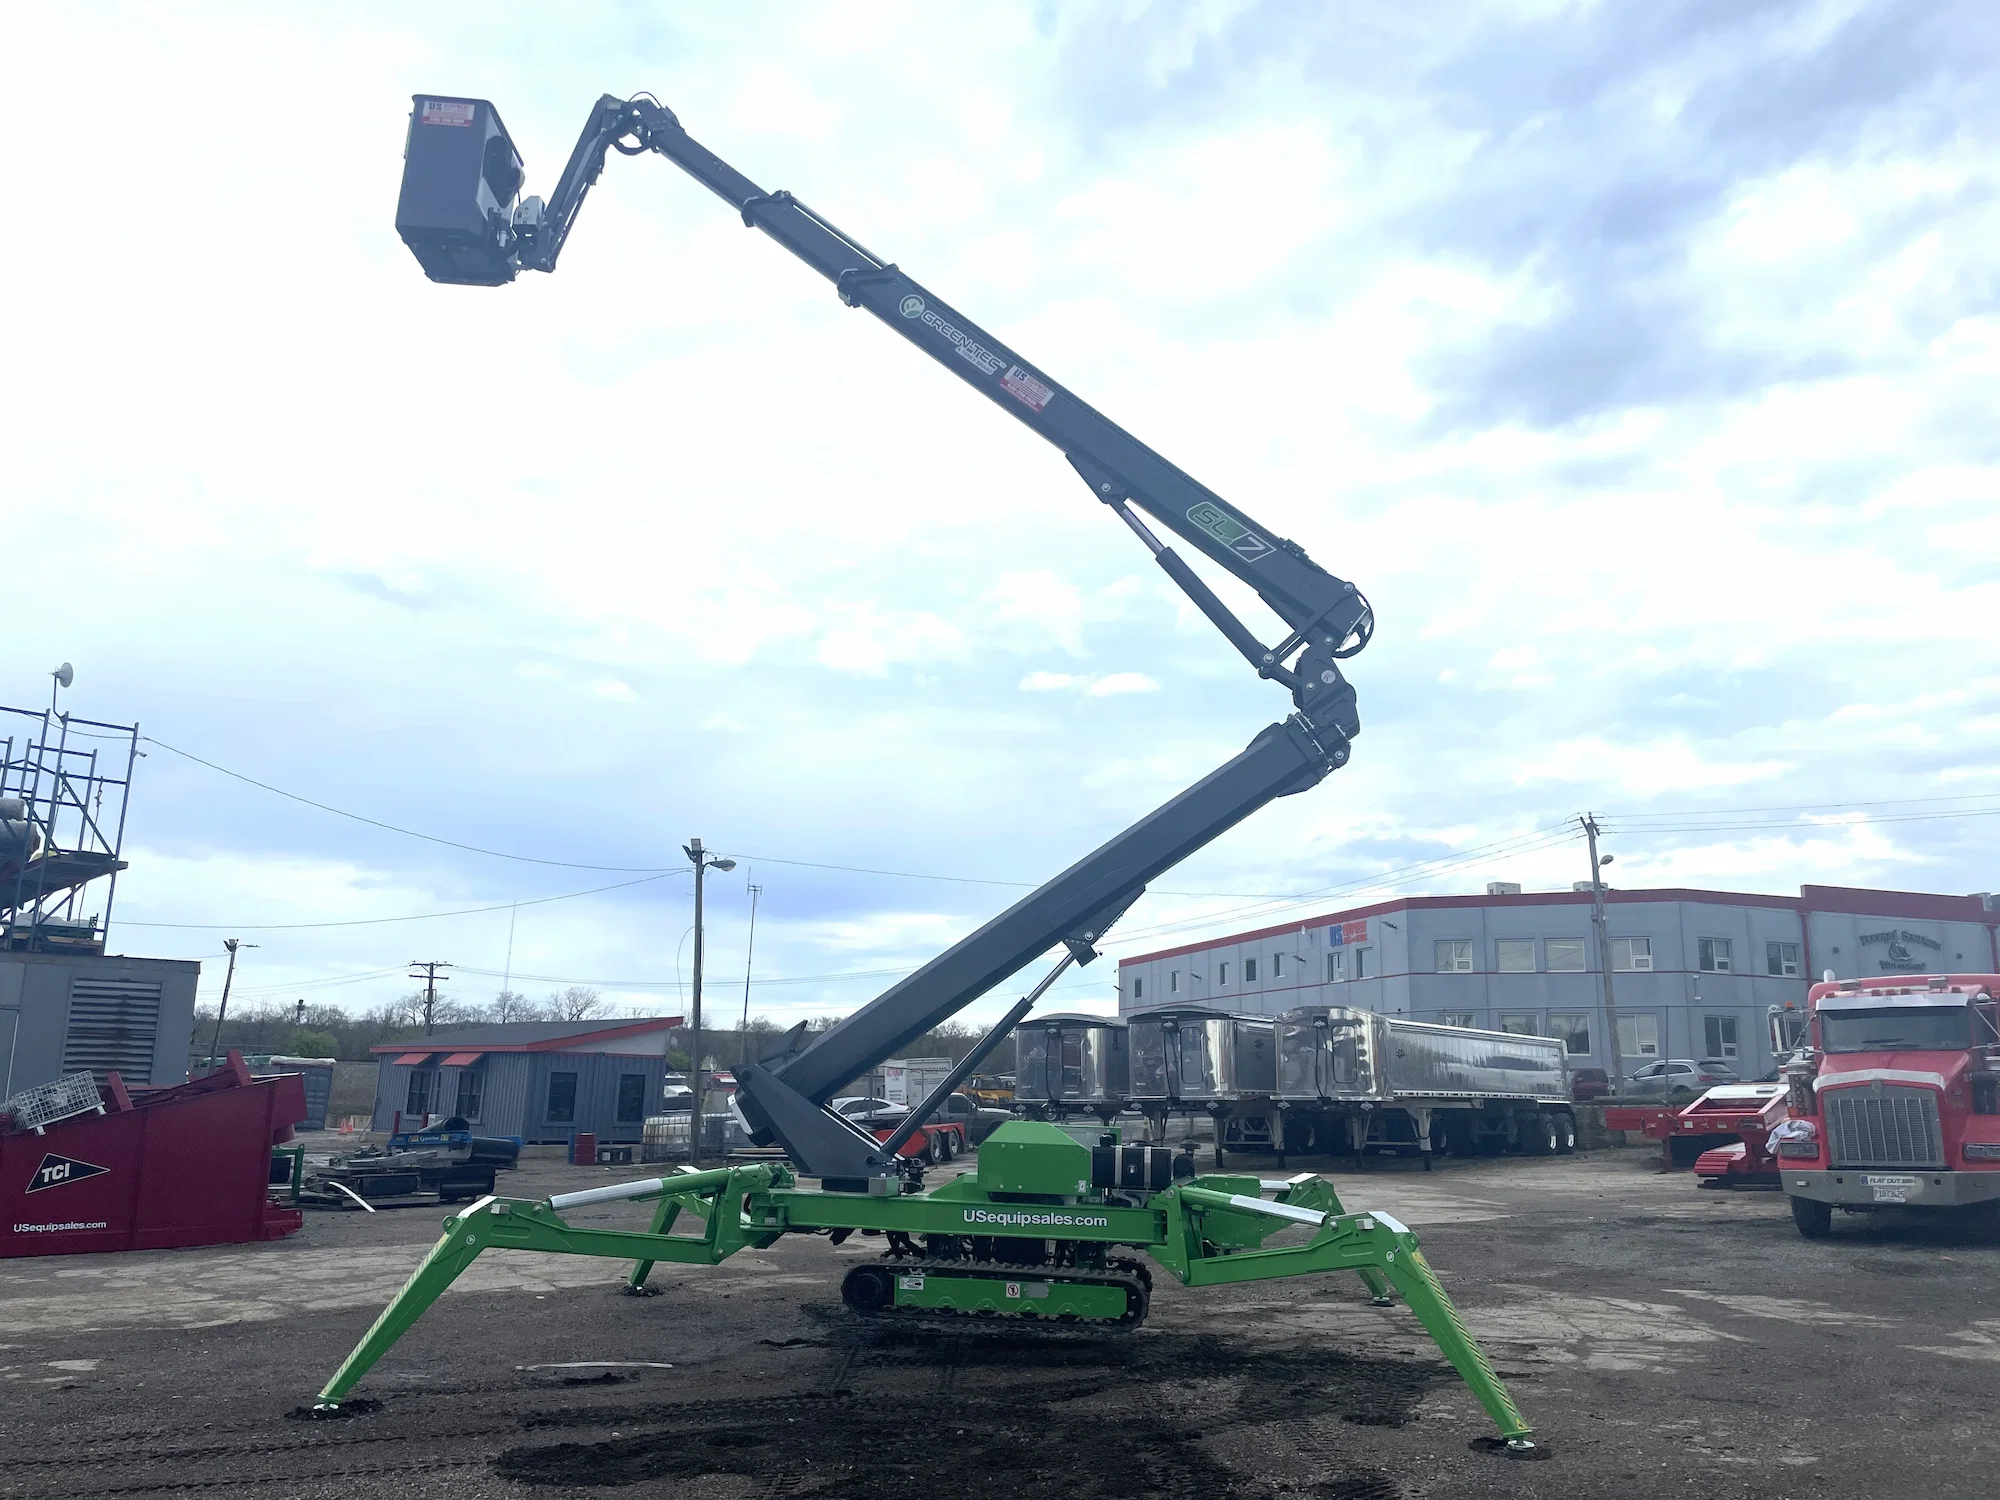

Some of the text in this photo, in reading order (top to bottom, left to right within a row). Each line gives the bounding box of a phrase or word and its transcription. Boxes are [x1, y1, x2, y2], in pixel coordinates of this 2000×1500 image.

[1013, 369, 1027, 381] US
[41, 1162, 71, 1183] TCI
[963, 1208, 1108, 1228] USequipsales.com
[13, 1221, 107, 1234] USequipsales.com
